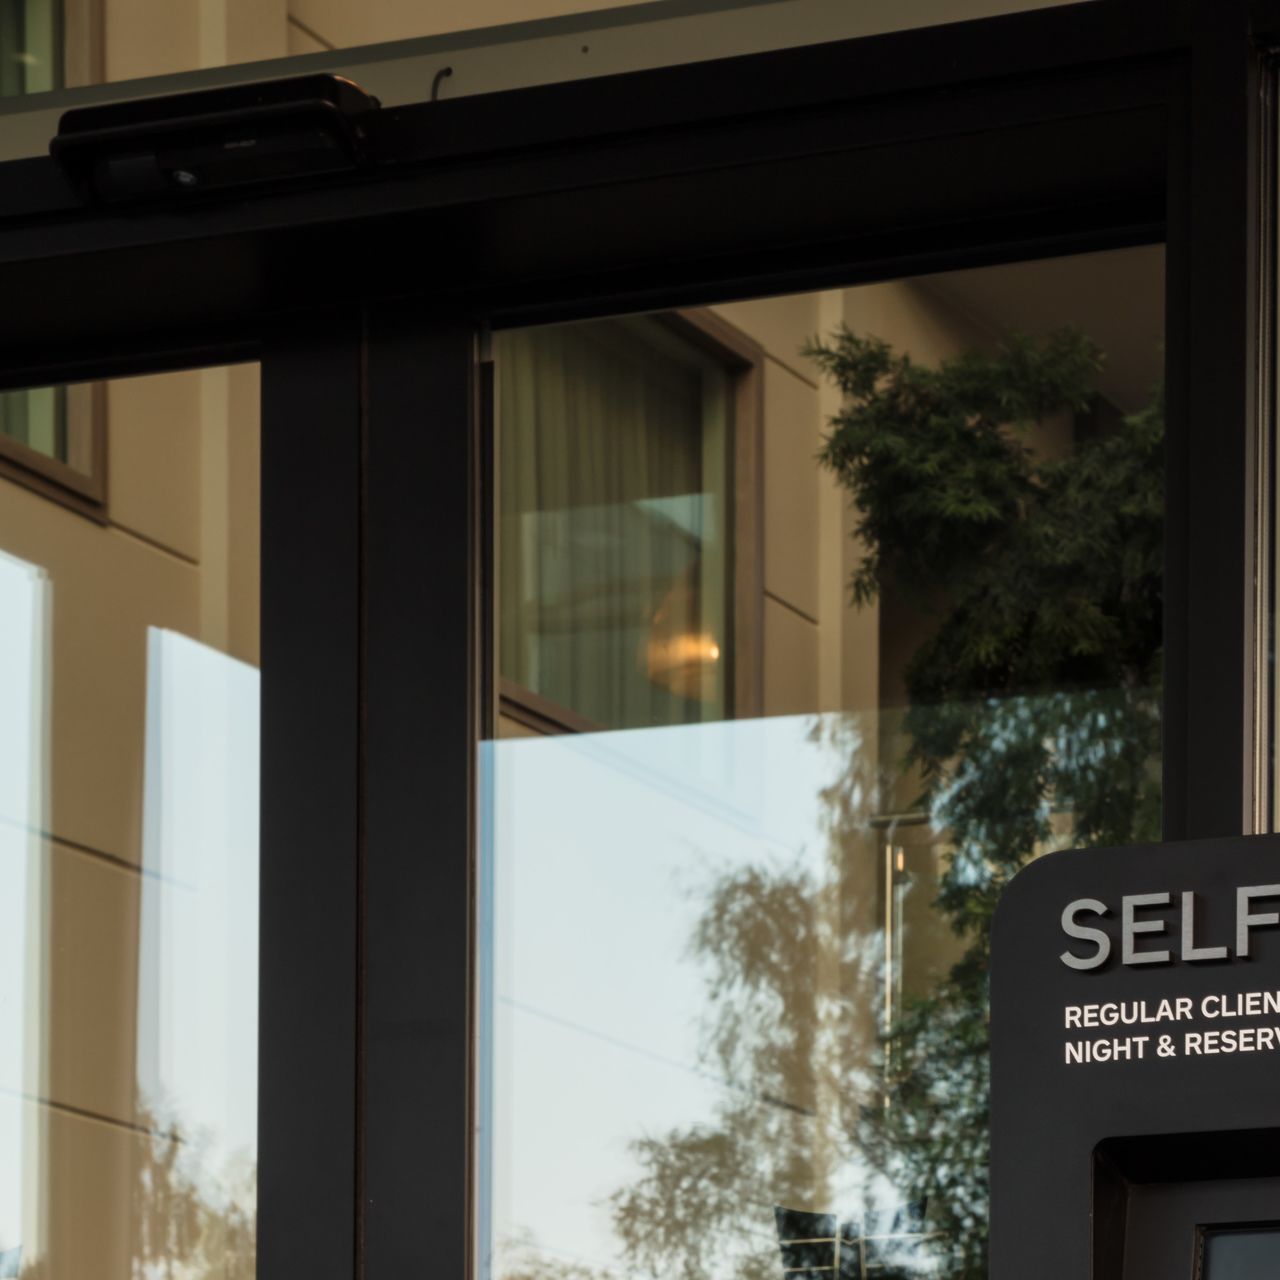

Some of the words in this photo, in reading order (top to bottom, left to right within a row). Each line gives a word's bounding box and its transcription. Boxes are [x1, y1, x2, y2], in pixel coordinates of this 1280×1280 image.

[1065, 997, 1193, 1029] REGULAR
[1065, 1036, 1150, 1064] NIGHT
[1156, 1034, 1176, 1058] &
